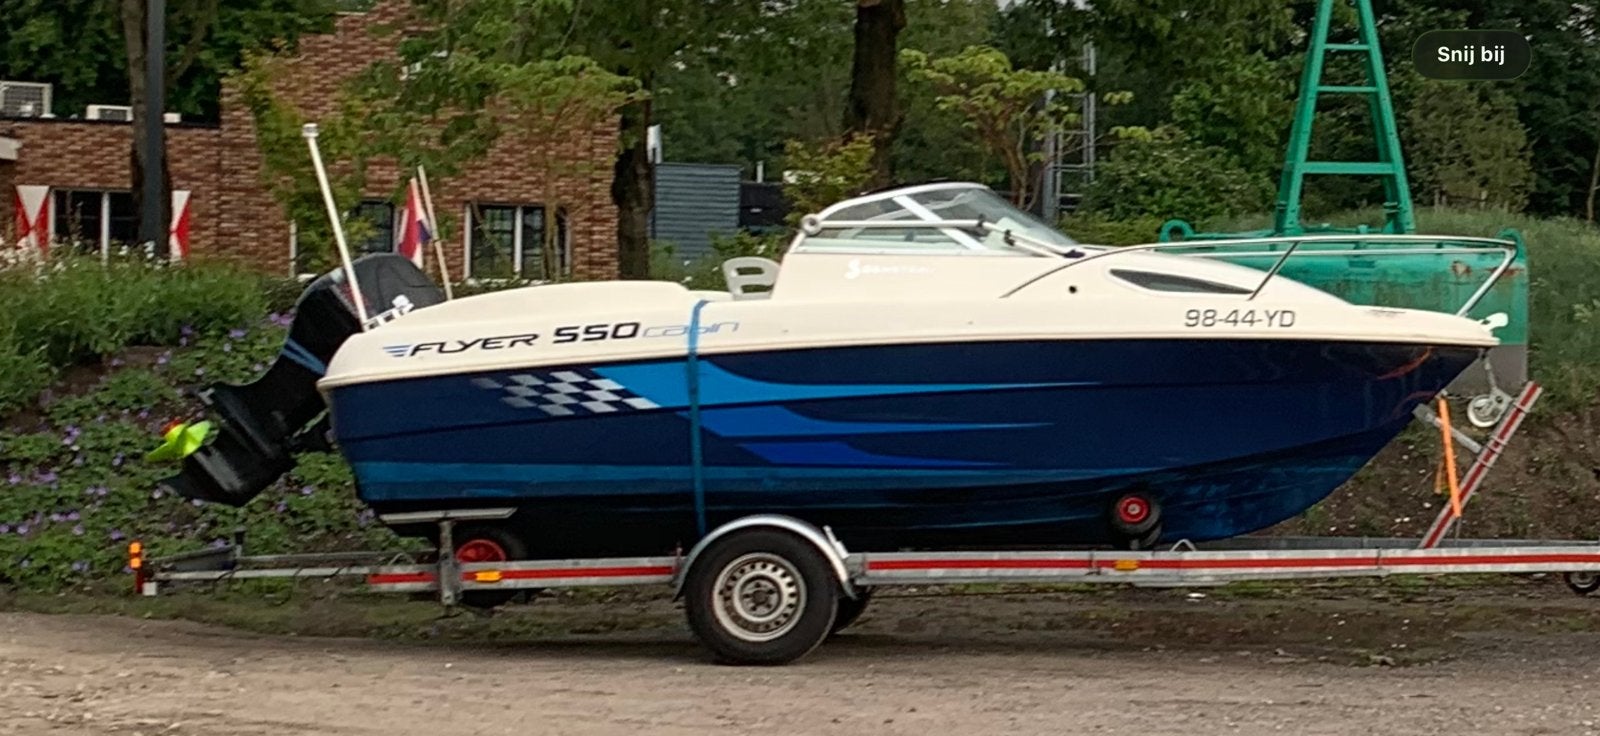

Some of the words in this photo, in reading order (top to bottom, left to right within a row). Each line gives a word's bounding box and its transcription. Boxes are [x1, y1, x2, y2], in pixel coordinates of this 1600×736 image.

[1184, 308, 1296, 328] 98-44-YD
[409, 333, 539, 357] FLYER
[552, 321, 641, 344] 550
